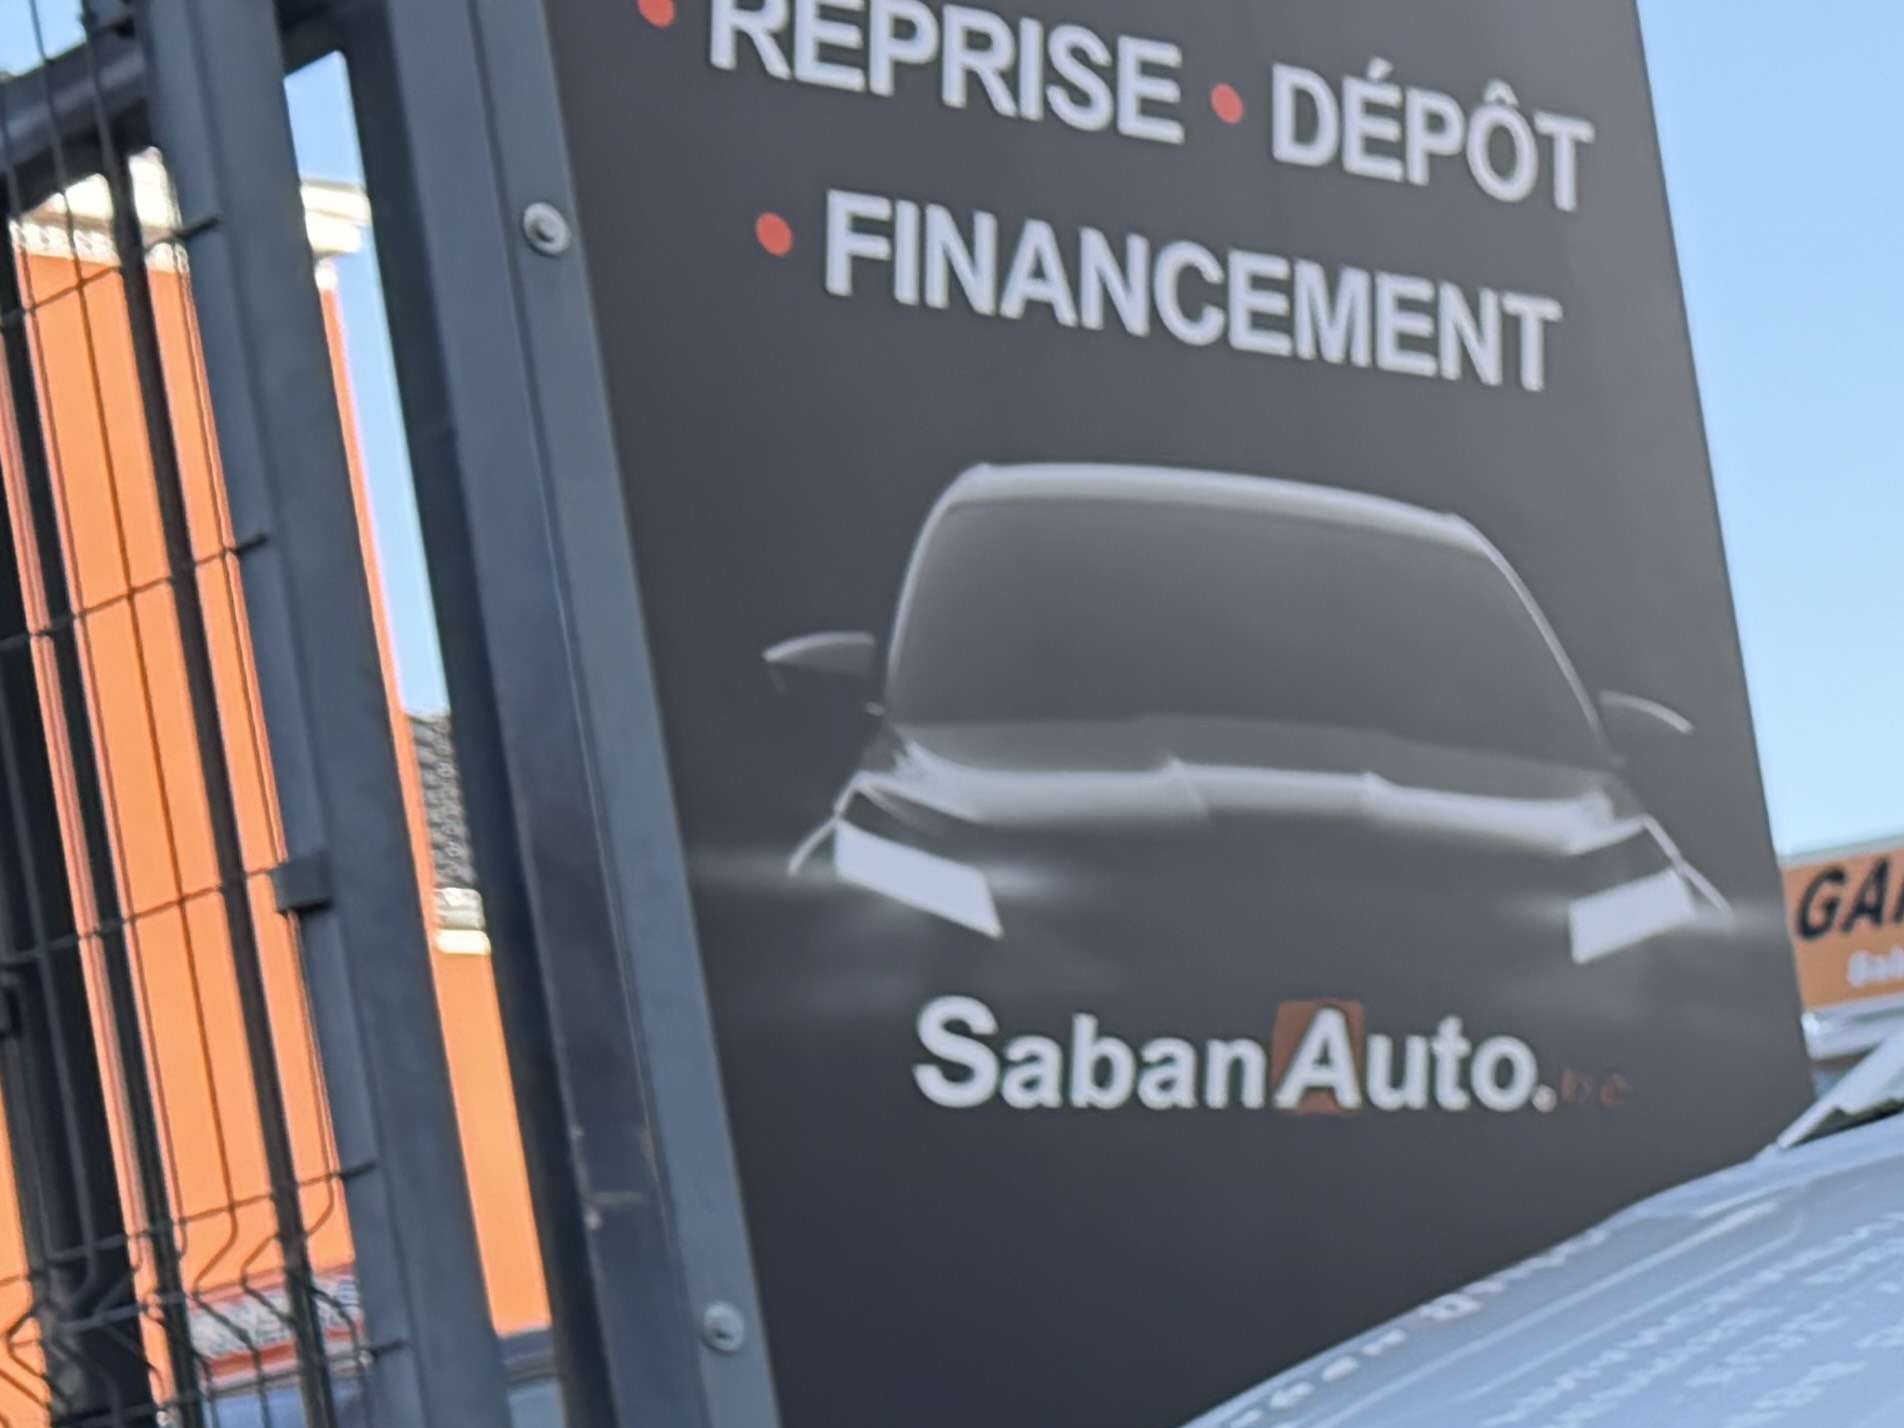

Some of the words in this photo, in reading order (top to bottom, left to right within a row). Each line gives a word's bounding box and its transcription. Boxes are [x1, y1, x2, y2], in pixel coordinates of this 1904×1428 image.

[708, 0, 1187, 145] REPRISE
[1270, 58, 1594, 212] DÉPÔT
[824, 190, 1563, 391] FINANCEMENT
